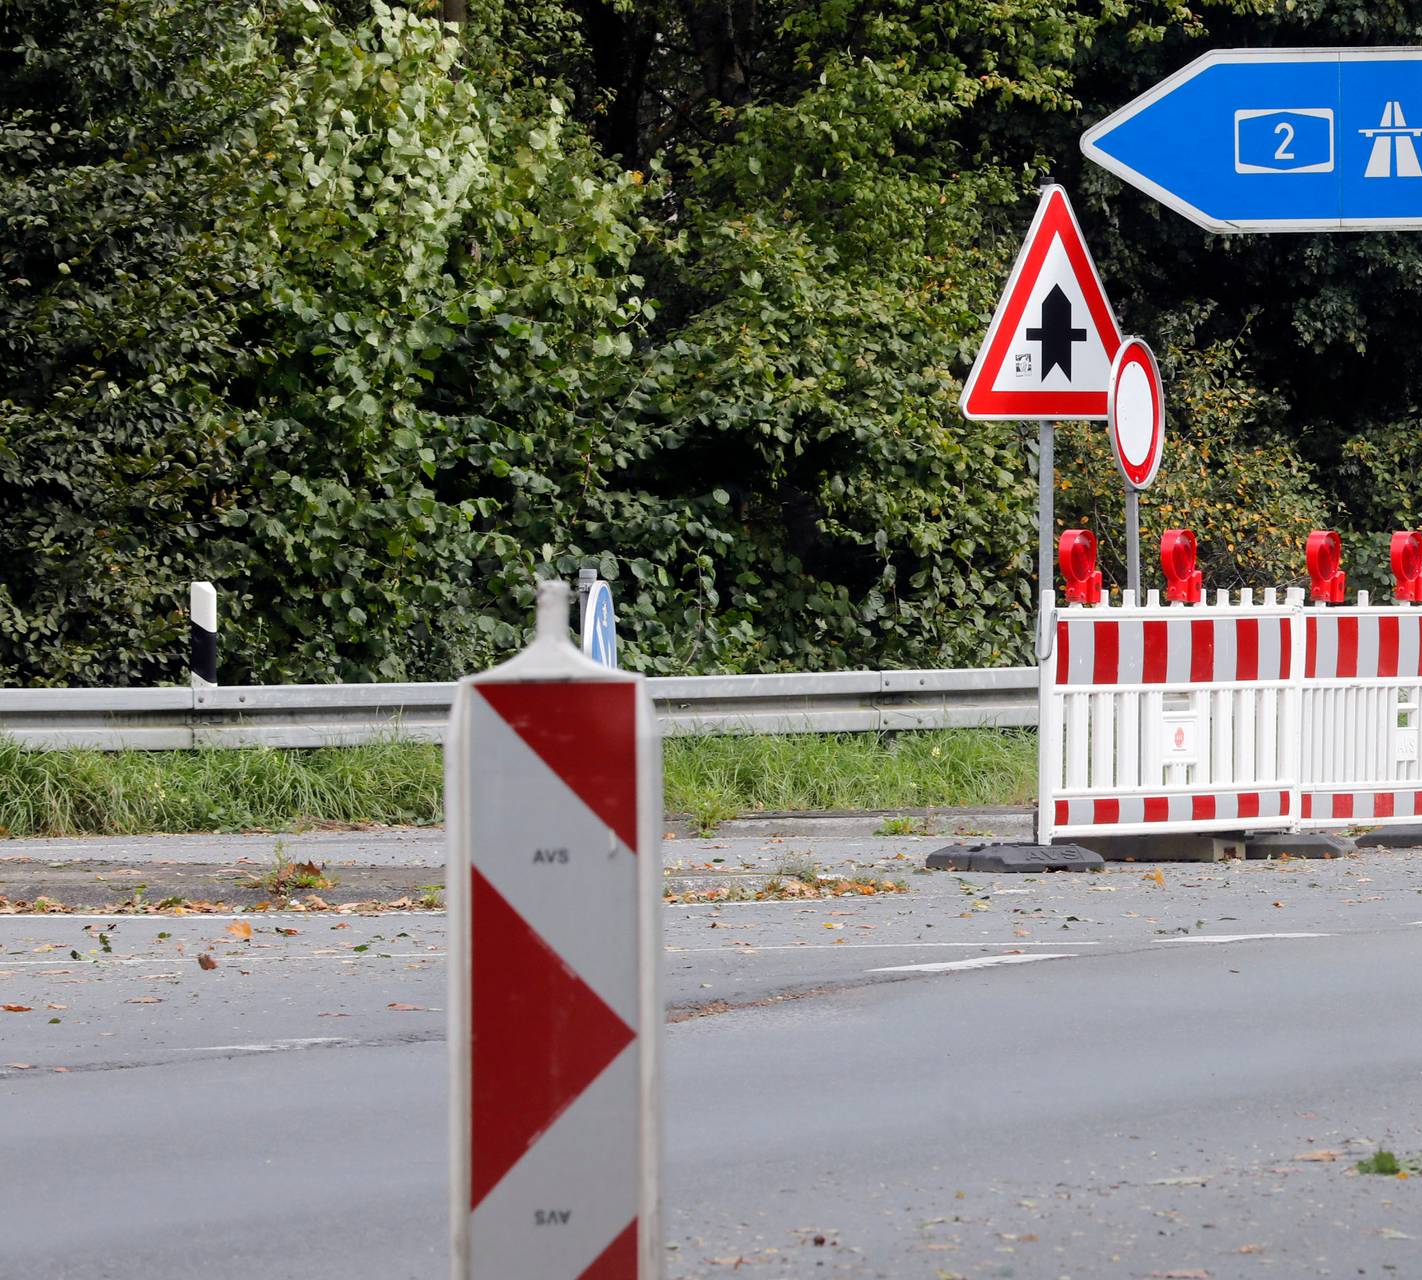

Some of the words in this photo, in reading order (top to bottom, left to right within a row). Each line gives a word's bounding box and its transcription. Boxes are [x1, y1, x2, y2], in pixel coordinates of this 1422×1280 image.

[1274, 122, 1295, 160] 2
[532, 848, 570, 864] AVS
[533, 1209, 572, 1225] AVS
